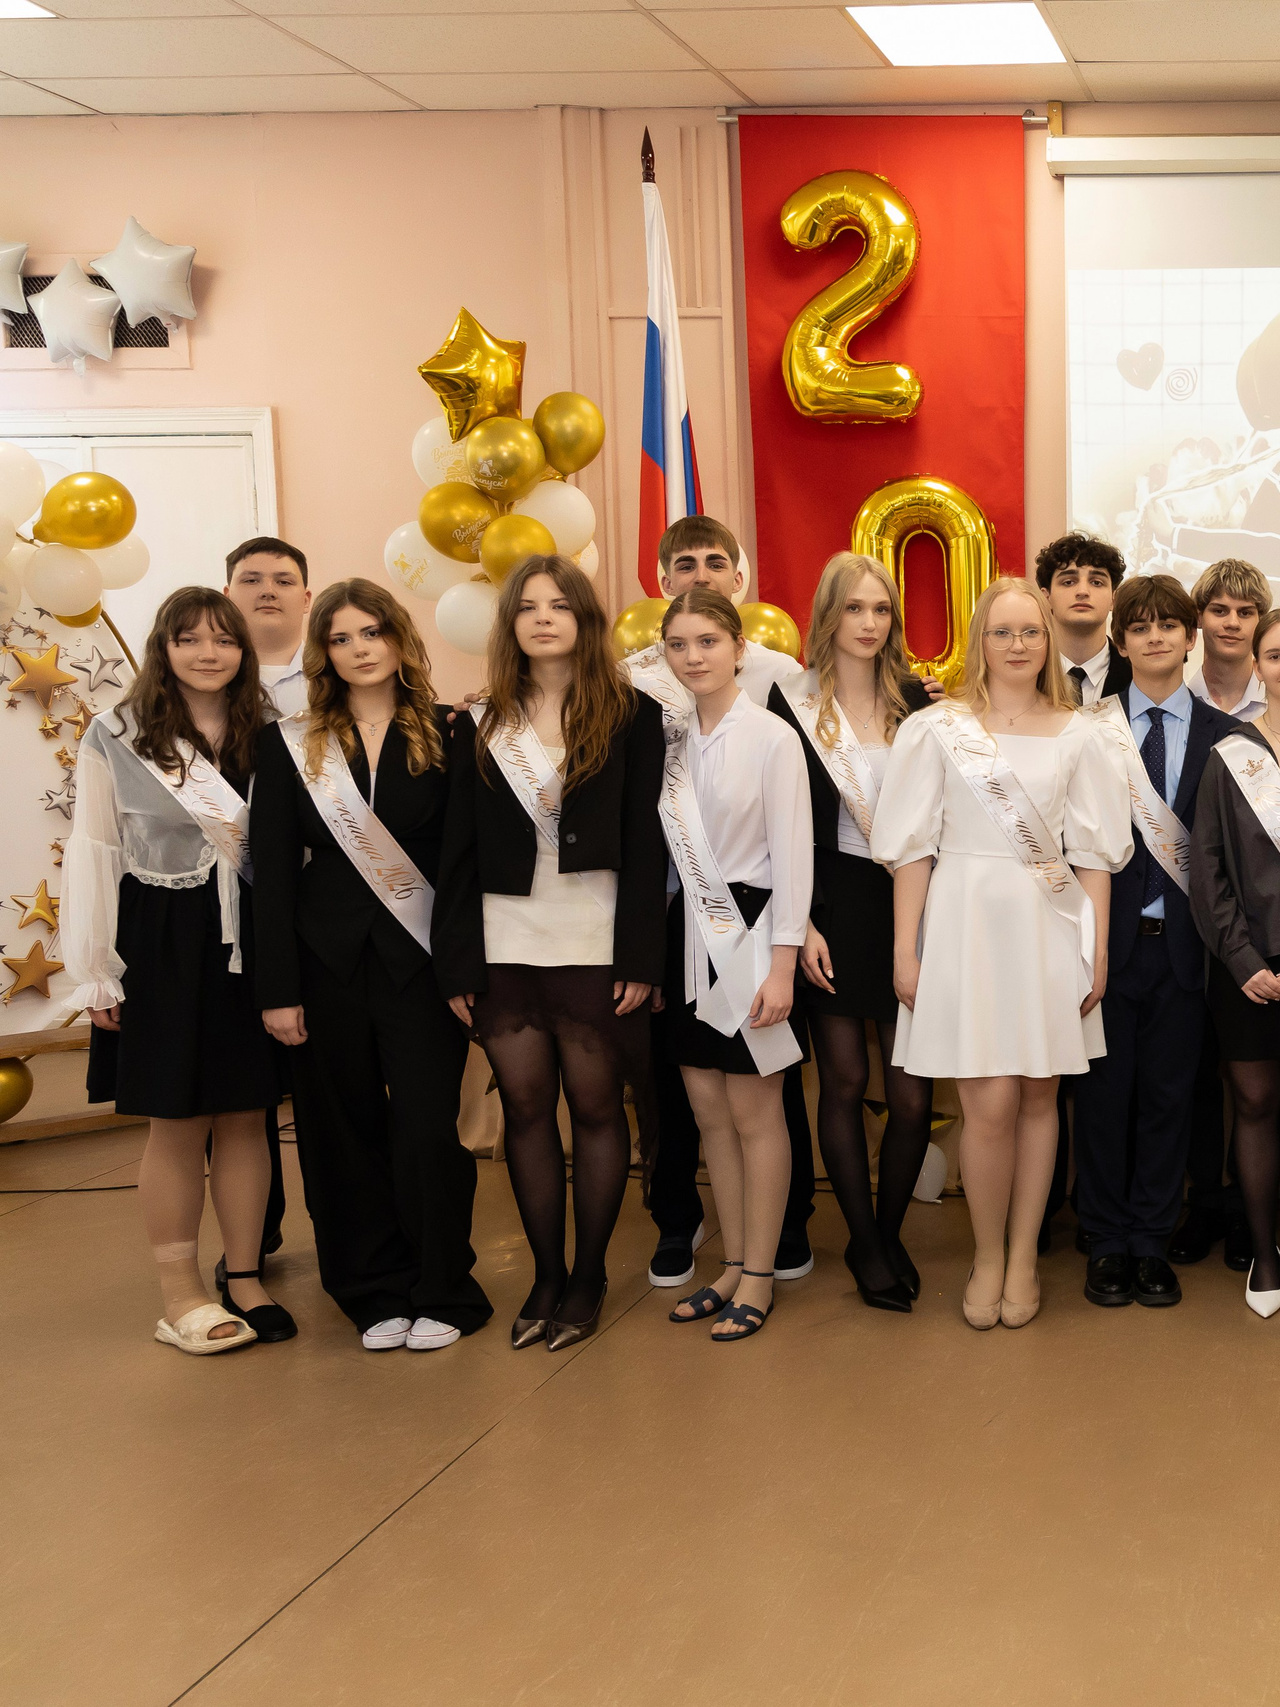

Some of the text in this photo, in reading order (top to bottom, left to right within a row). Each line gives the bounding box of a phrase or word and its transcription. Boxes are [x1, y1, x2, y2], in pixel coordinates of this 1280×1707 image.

[780, 169, 924, 423] 2
[851, 473, 1000, 688] 0
[373, 862, 424, 900] 2026
[662, 755, 711, 892] Выпускница
[700, 896, 740, 934] 2026
[1033, 856, 1072, 893] 2026
